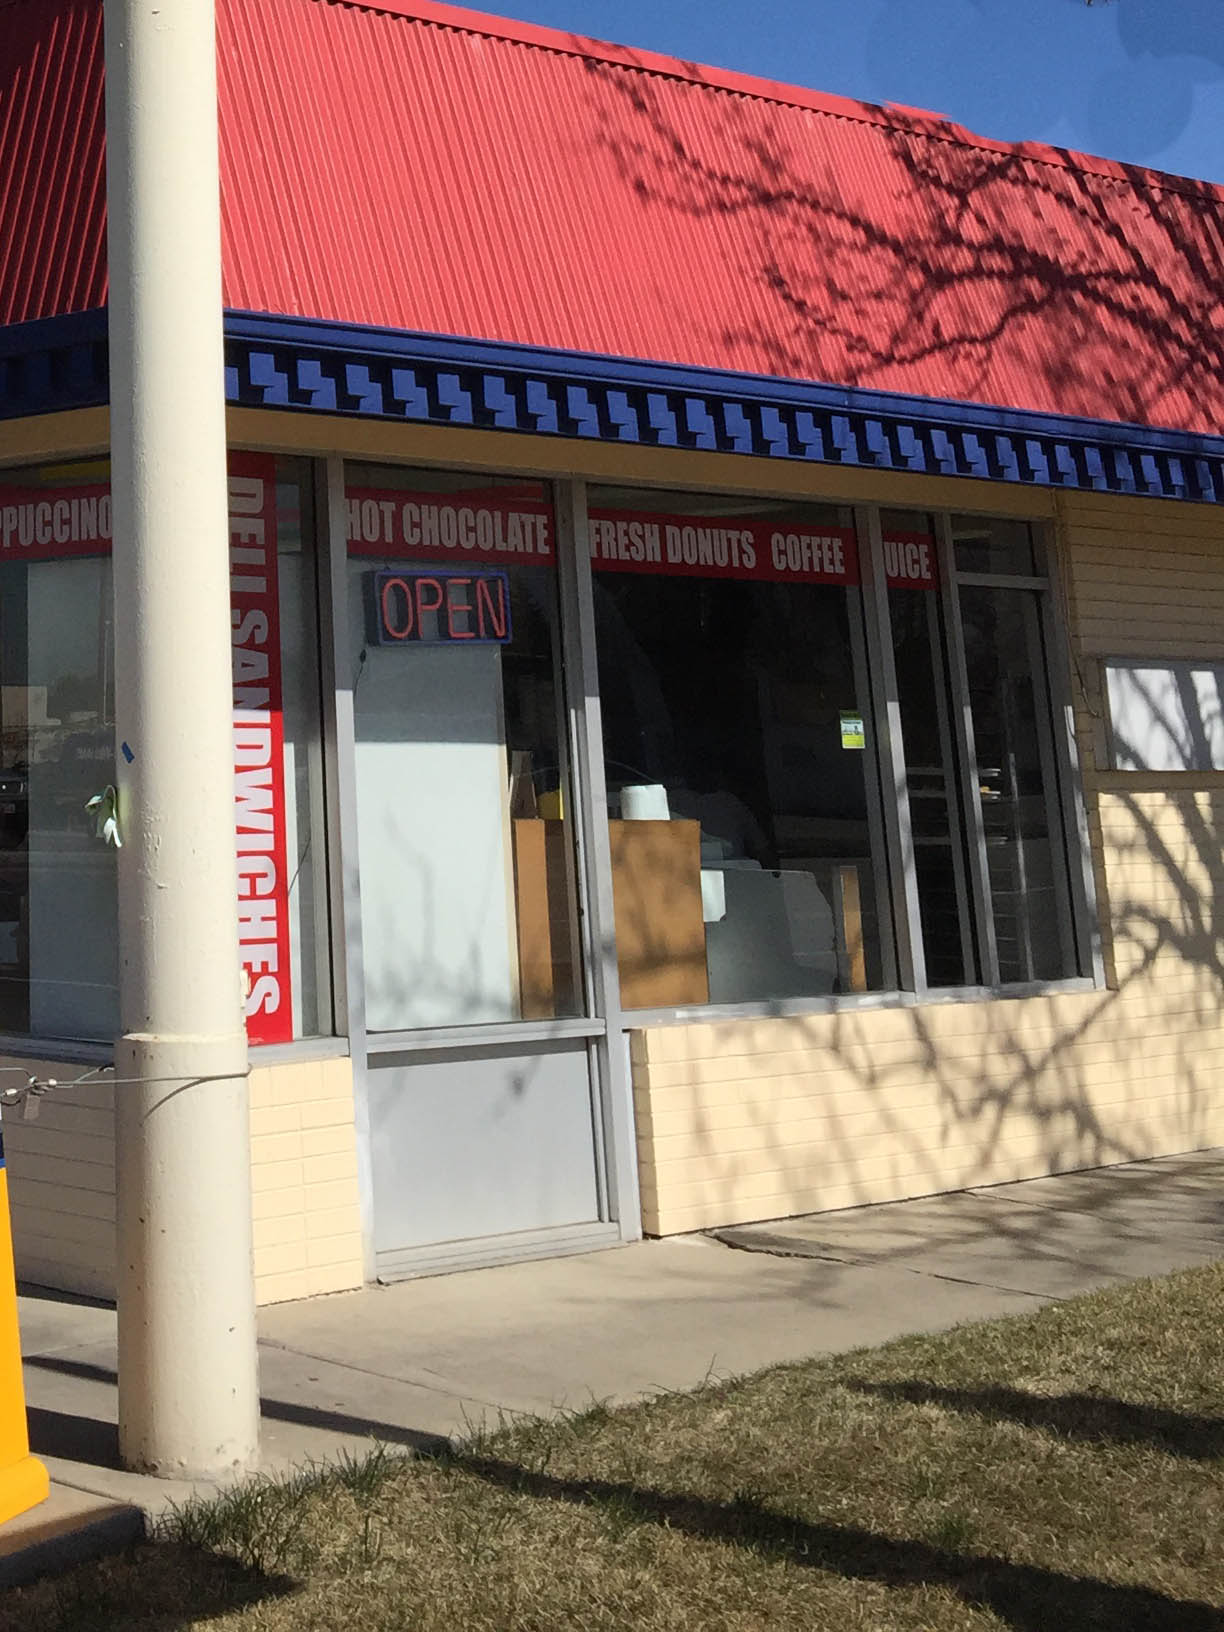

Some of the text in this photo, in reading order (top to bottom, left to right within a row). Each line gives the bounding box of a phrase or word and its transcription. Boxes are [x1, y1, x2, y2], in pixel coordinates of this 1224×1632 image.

[227, 476, 267, 593] DELI
[344, 498, 550, 554] HOT CHOCOLATE
[589, 519, 845, 574] FRESH DONUTS COFFEE
[883, 541, 932, 580] UICE
[381, 578, 507, 639] OPEN
[232, 608, 281, 1017] SANDWICHES
